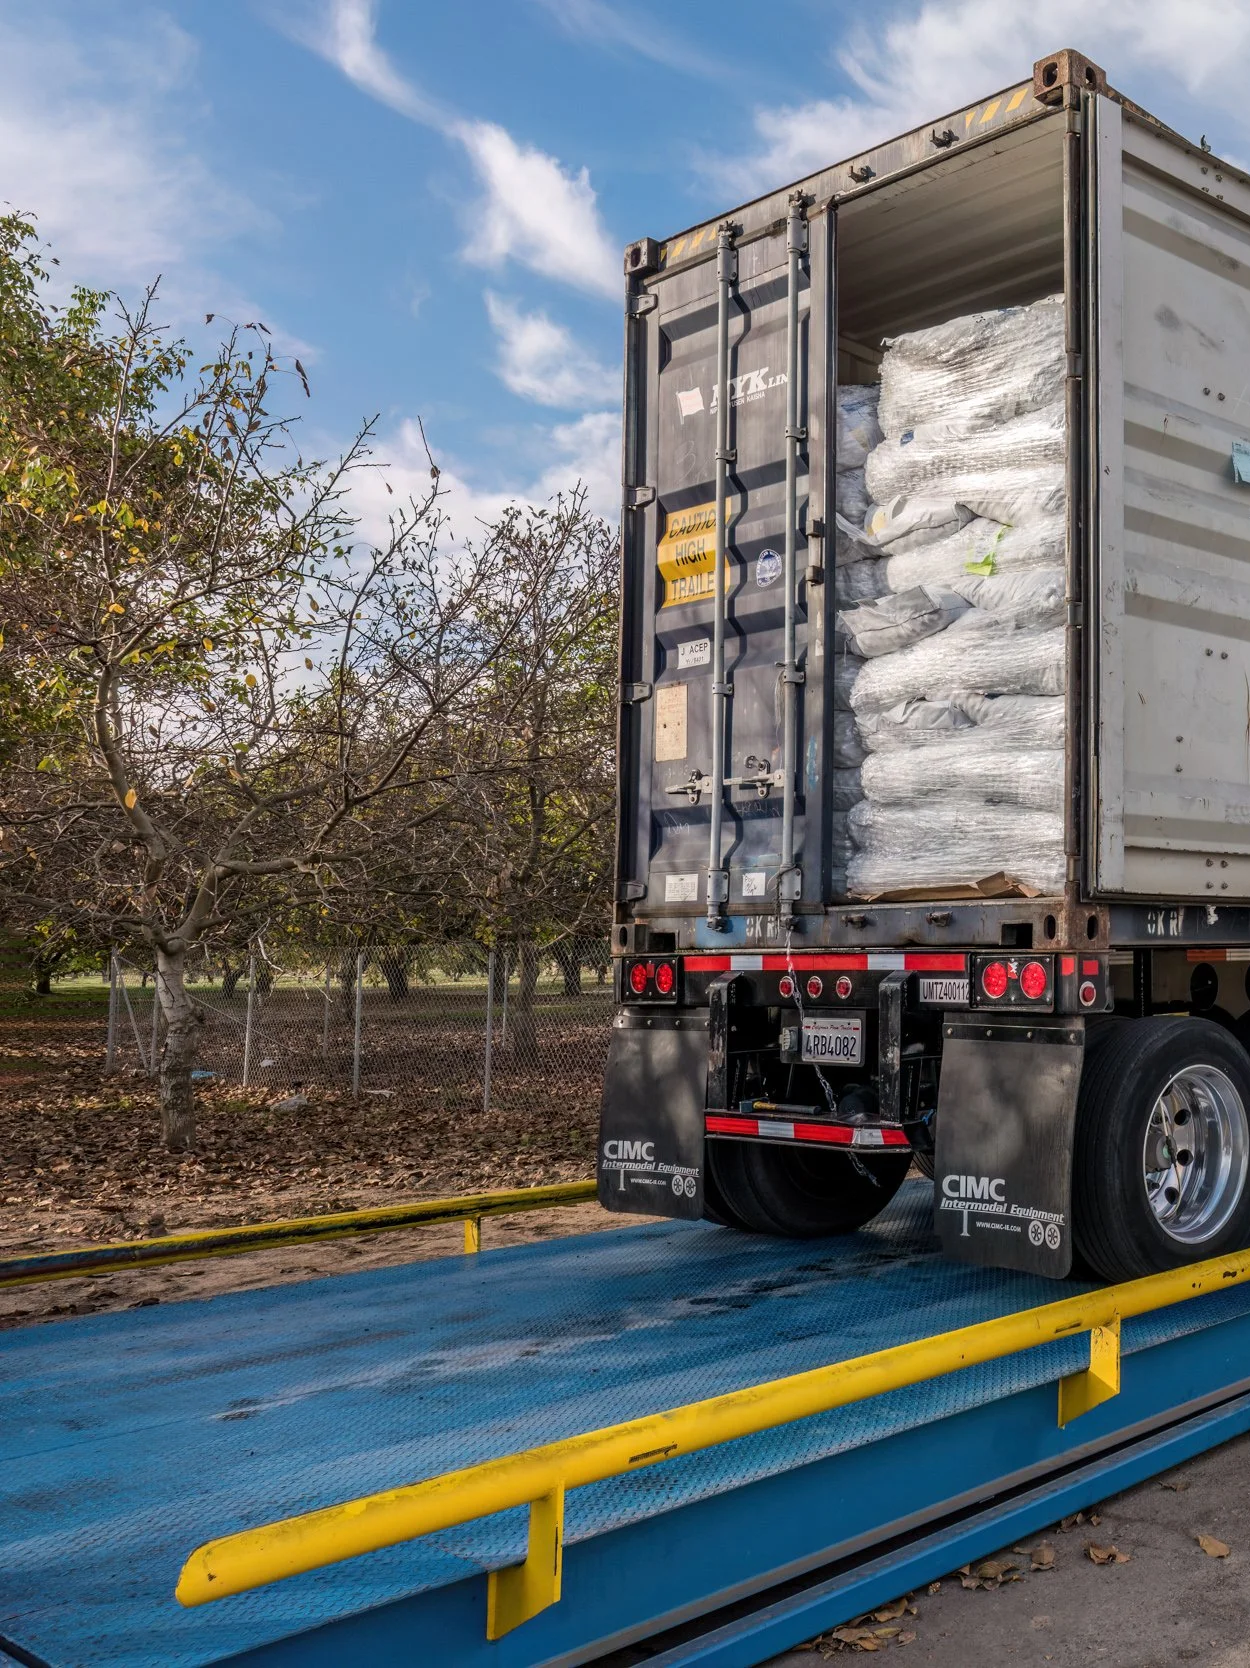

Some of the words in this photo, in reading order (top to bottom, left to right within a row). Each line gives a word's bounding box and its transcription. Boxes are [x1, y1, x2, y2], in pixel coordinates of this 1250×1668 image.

[767, 373, 789, 389] LIN
[669, 508, 717, 539] CAUTIO
[675, 538, 708, 567] HIGH
[671, 571, 715, 601] TRAILE
[805, 1034, 857, 1057] 4RB4082
[603, 1139, 655, 1161] CIMC
[601, 1159, 656, 1171] Intermodal
[657, 1162, 700, 1177] Equipment
[942, 1174, 1006, 1202] CIMC
[940, 1197, 1008, 1214] Intermodal
[1010, 1204, 1065, 1223] Equipment
